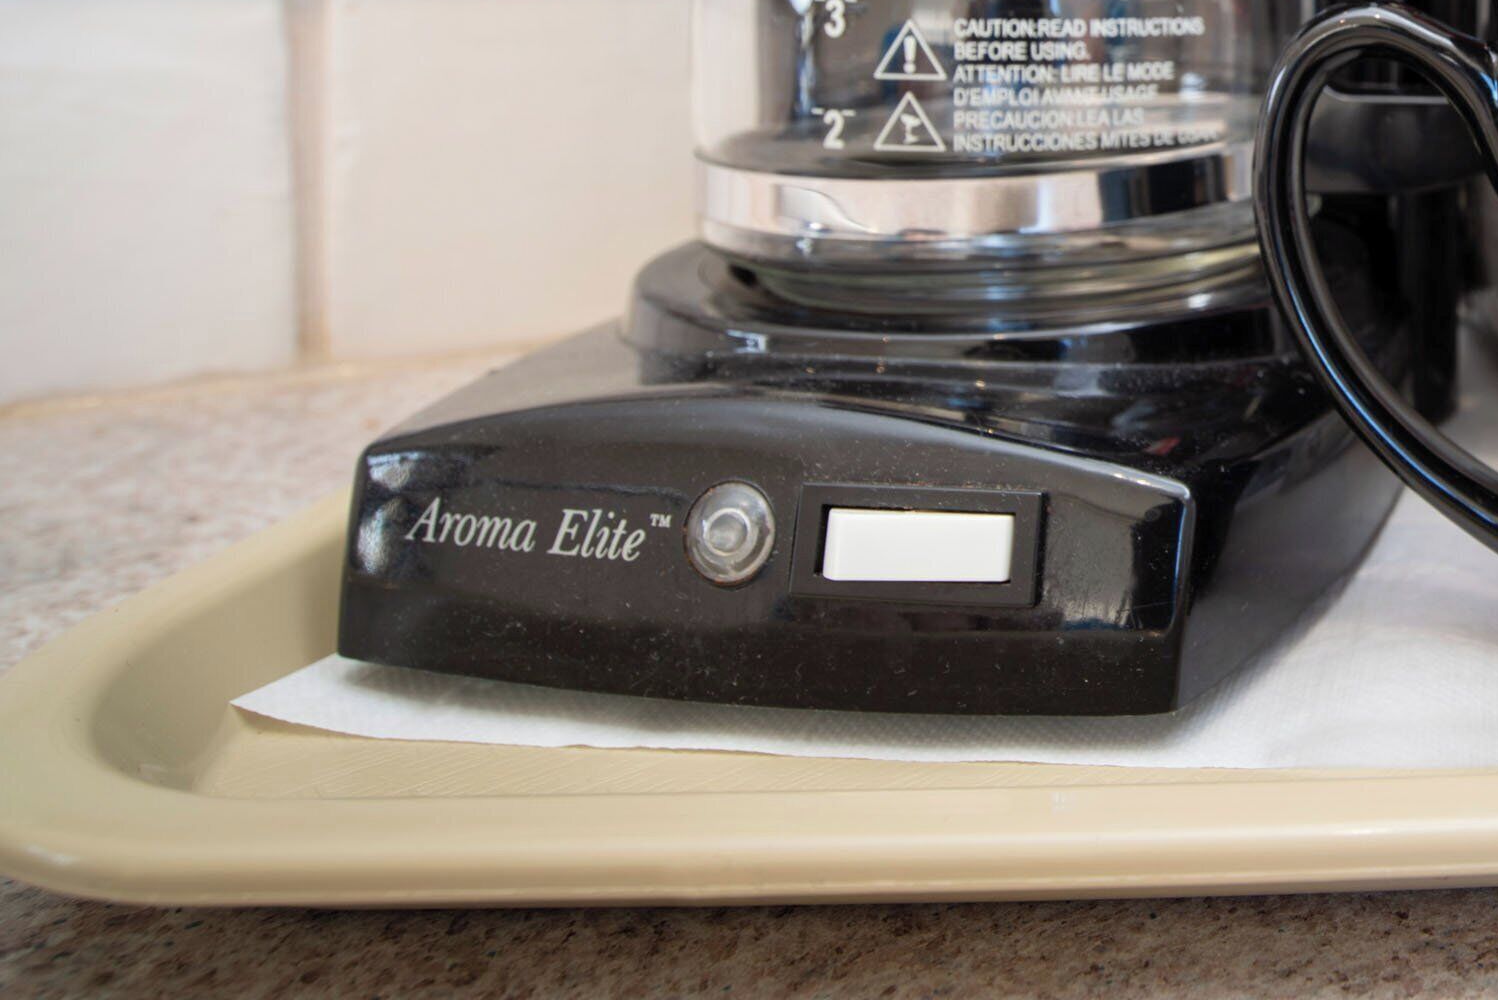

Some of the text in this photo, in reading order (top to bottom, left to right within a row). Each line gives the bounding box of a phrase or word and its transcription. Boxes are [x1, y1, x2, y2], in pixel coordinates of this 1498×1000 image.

[1089, 16, 1205, 38] INSTRUCTIONS
[953, 39, 1028, 61] BEFORE
[1061, 62, 1099, 83] LIRE
[1102, 61, 1124, 83] LE
[1126, 60, 1175, 81] MODE
[823, 108, 845, 150] 2
[953, 131, 1099, 153] INSTRUCCIONES
[404, 497, 537, 553] Aroma
